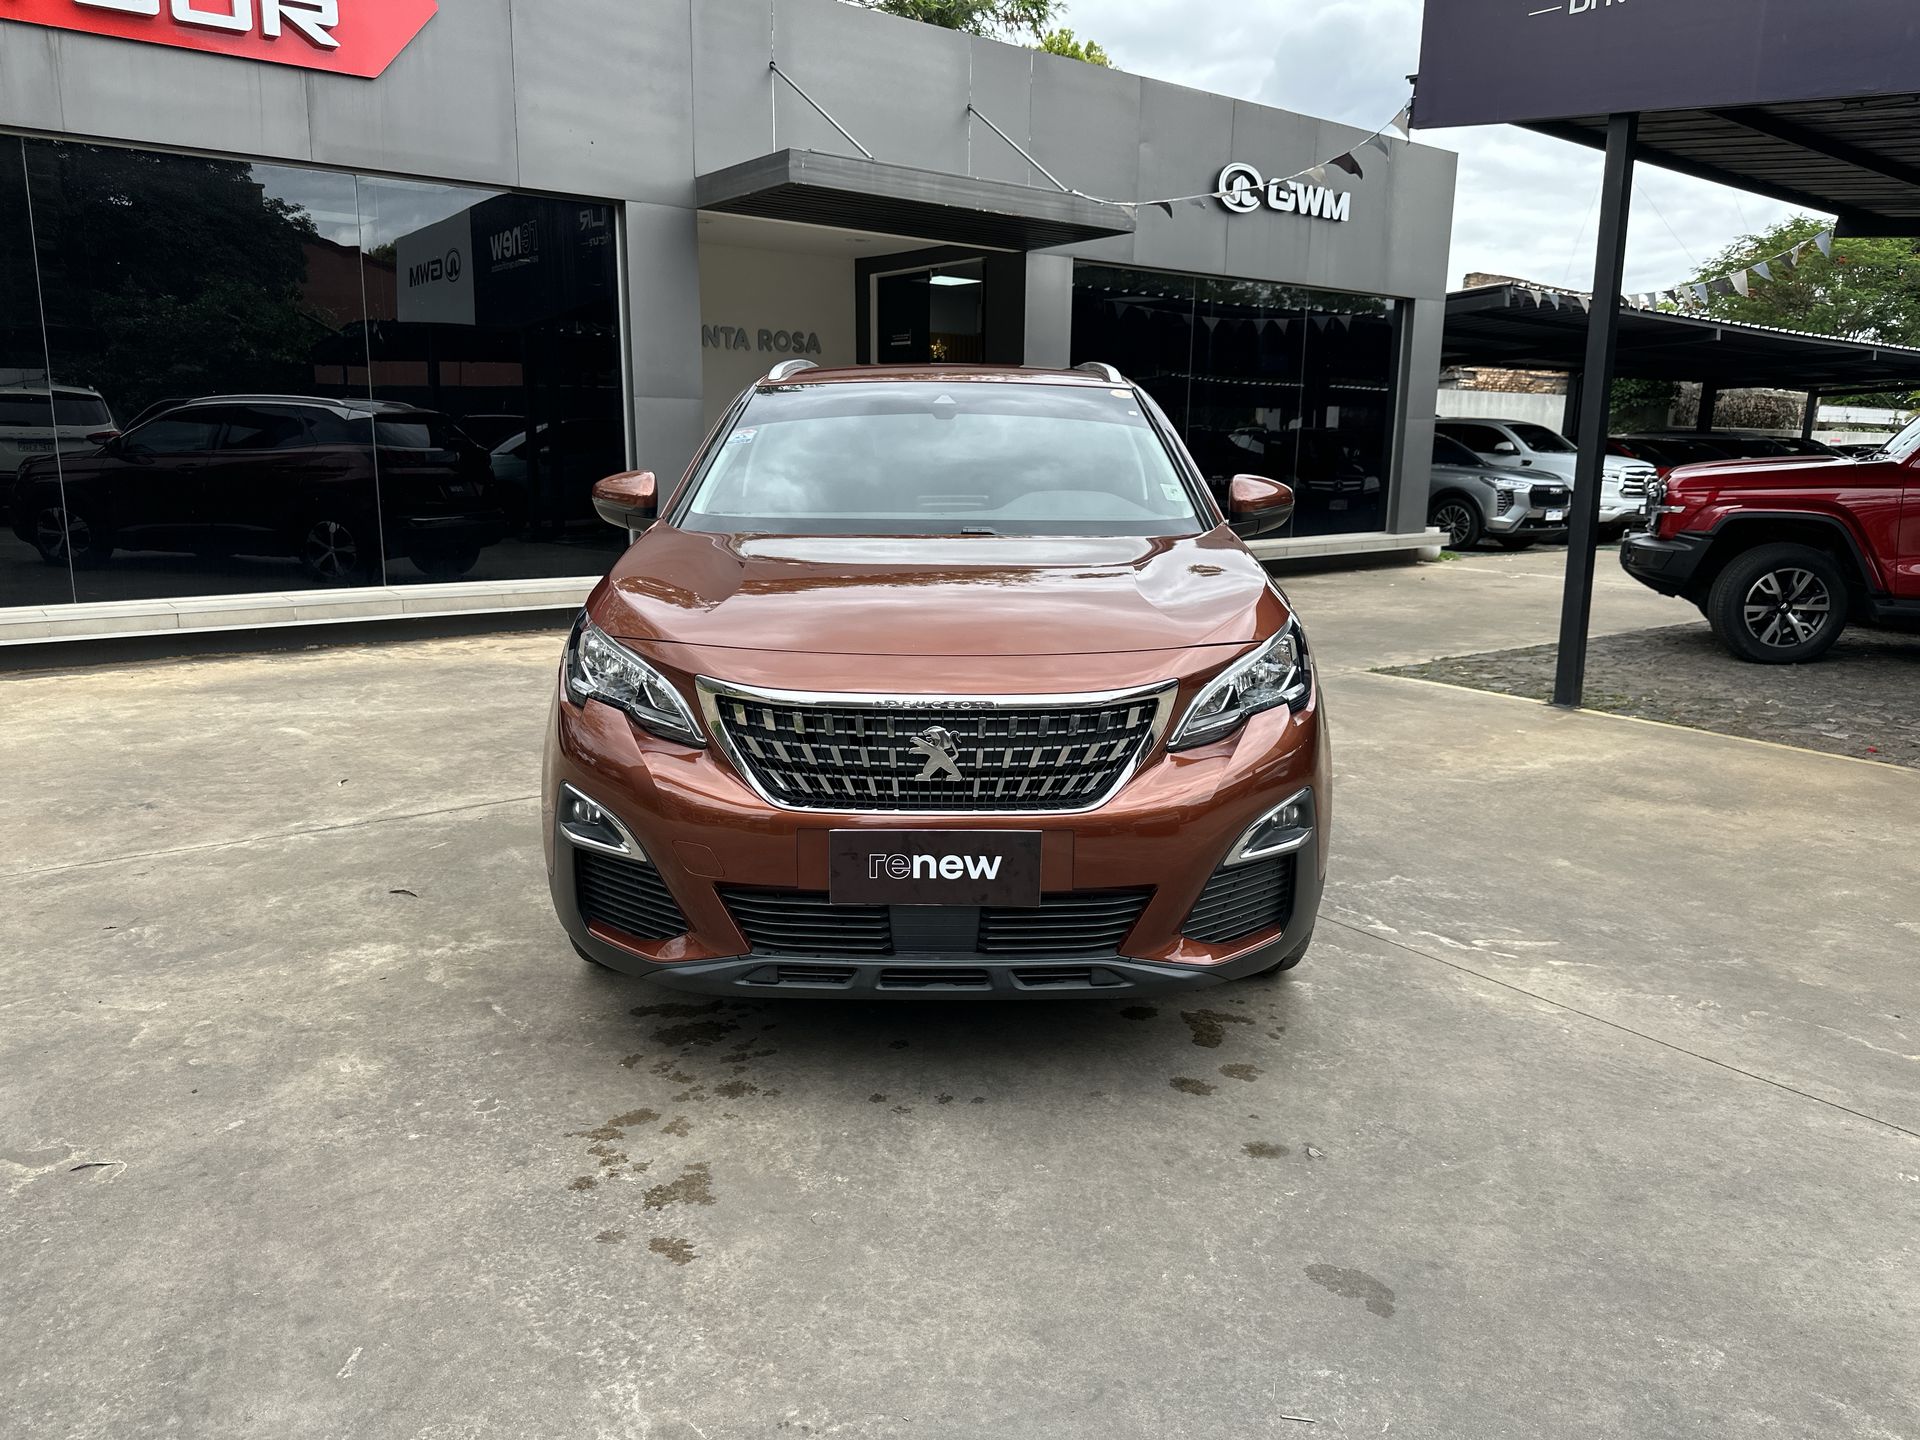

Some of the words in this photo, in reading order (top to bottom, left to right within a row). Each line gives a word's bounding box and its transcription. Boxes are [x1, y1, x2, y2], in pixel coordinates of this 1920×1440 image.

[1268, 177, 1351, 222] GWM
[757, 328, 822, 354] ROSA
[868, 853, 1003, 880] renew
